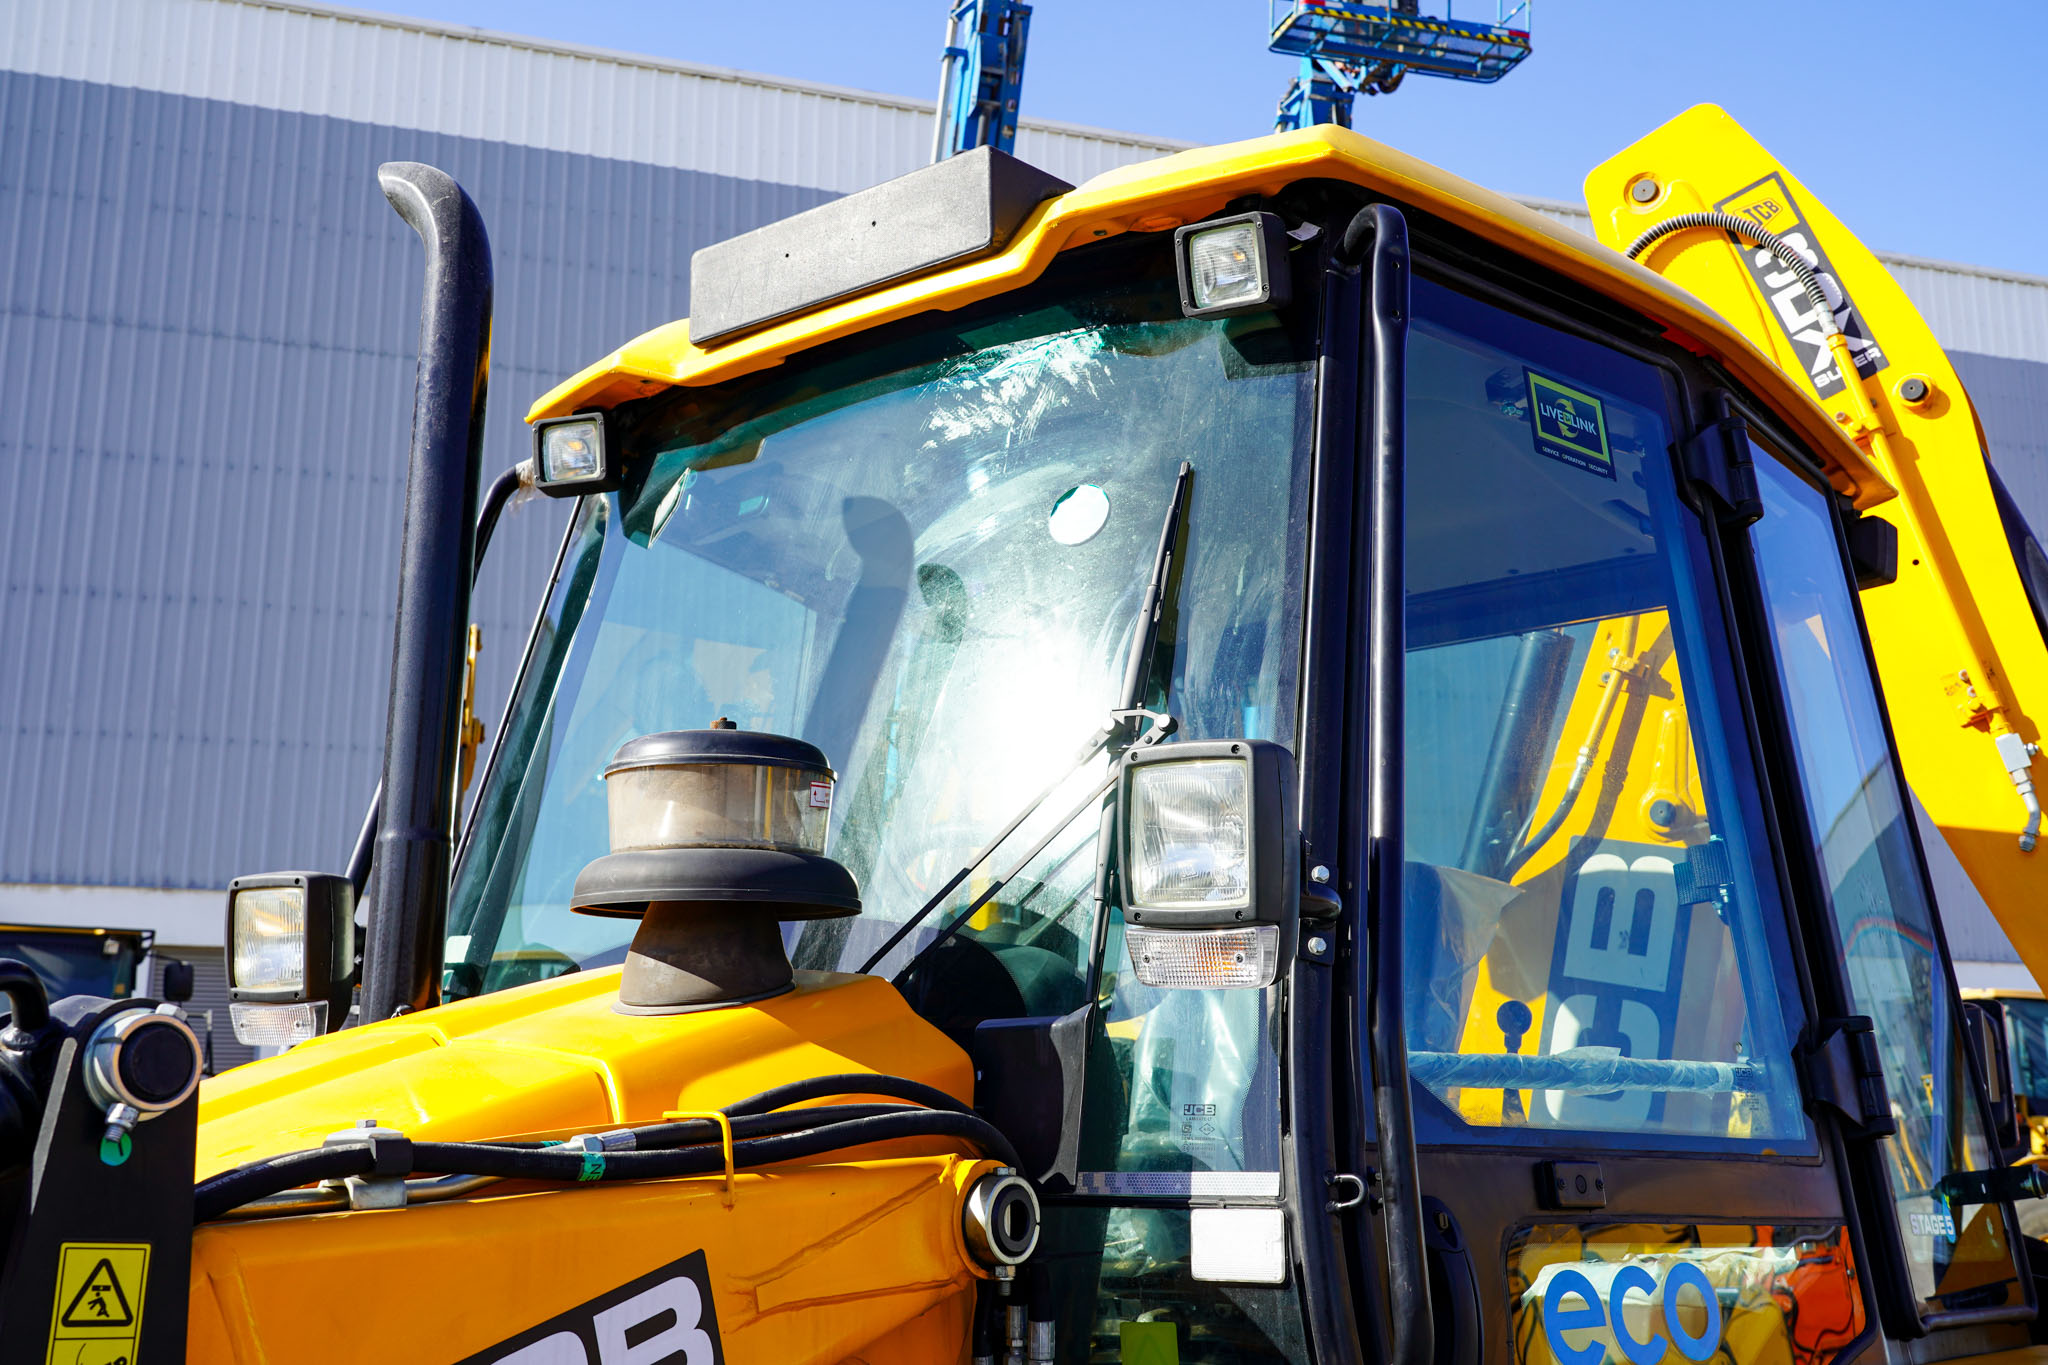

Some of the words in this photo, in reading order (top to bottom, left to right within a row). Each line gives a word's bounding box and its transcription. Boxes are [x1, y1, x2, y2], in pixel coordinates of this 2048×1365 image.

[1743, 200, 1780, 227] JCB
[1814, 347, 1881, 388] SUER
[1542, 446, 1559, 456] SERVICE
[1562, 453, 1586, 467] OPERATION
[1545, 853, 1679, 1128] CB
[1184, 1104, 1215, 1115] JCB
[1909, 1213, 1947, 1235] STAGE
[1944, 1215, 1955, 1235] 5
[1544, 1262, 1721, 1365] eco
